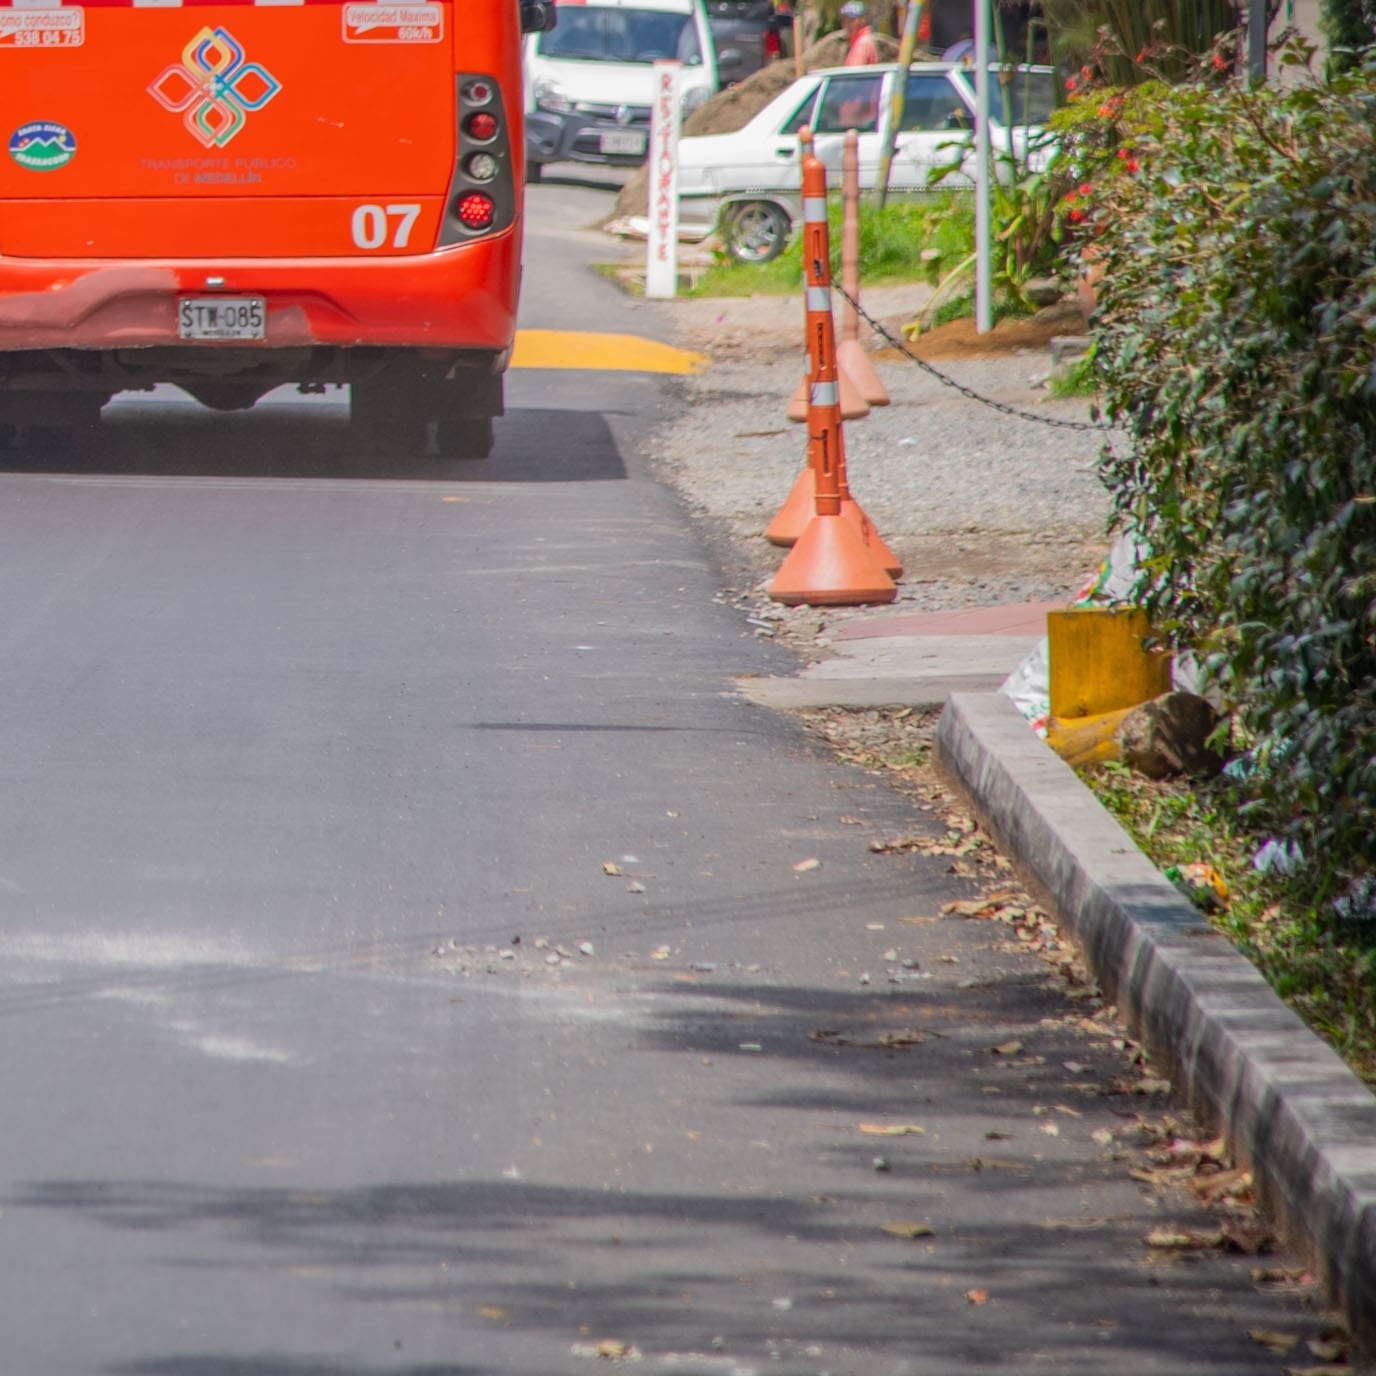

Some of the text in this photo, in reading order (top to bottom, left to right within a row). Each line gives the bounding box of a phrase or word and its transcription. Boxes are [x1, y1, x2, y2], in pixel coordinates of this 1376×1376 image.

[351, 10, 395, 22] Velocidad
[14, 31, 39, 45] 538
[62, 29, 81, 44] 75
[139, 158, 229, 170] TRANSPORTE
[173, 172, 190, 184] DE
[352, 204, 421, 249] 07
[182, 305, 262, 328] STW-085
